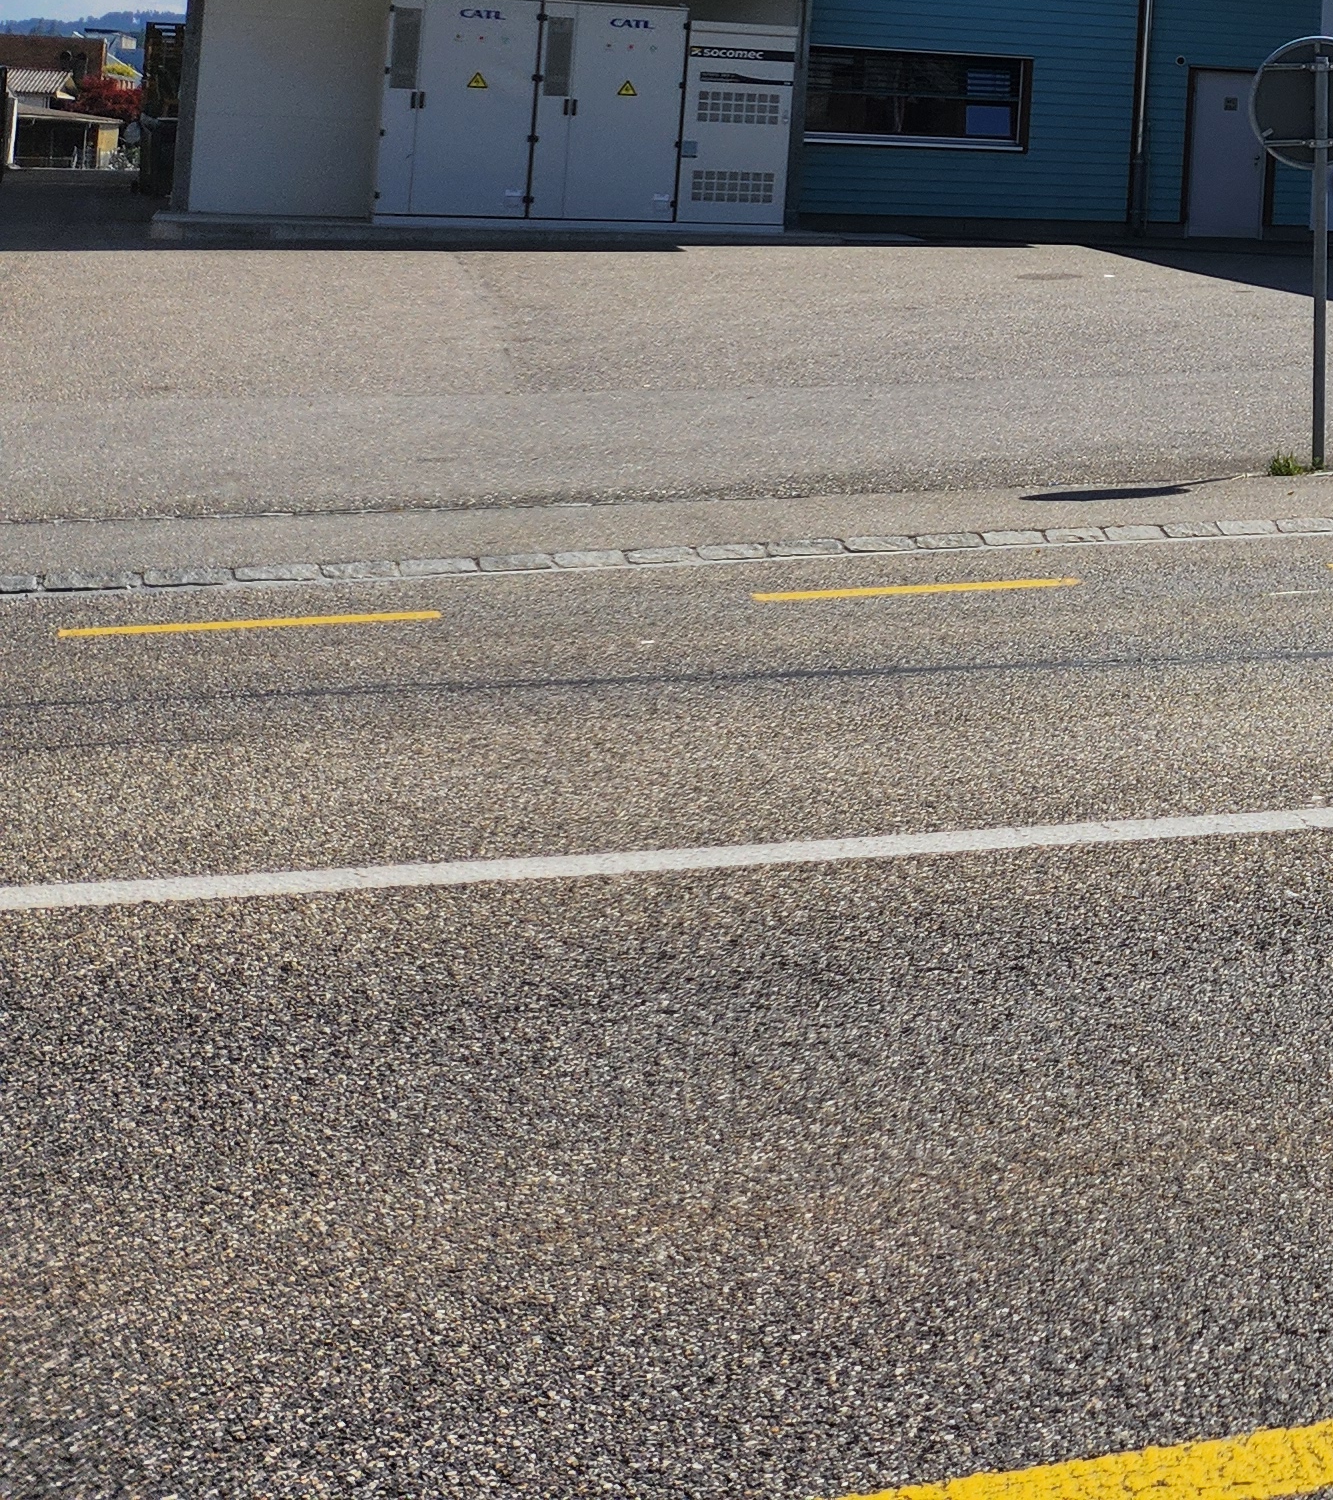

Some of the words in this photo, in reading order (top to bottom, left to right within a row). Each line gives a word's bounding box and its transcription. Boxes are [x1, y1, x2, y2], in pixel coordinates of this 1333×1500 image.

[460, 8, 506, 20] CATL
[610, 18, 656, 30] CATL
[704, 48, 765, 60] socomec
